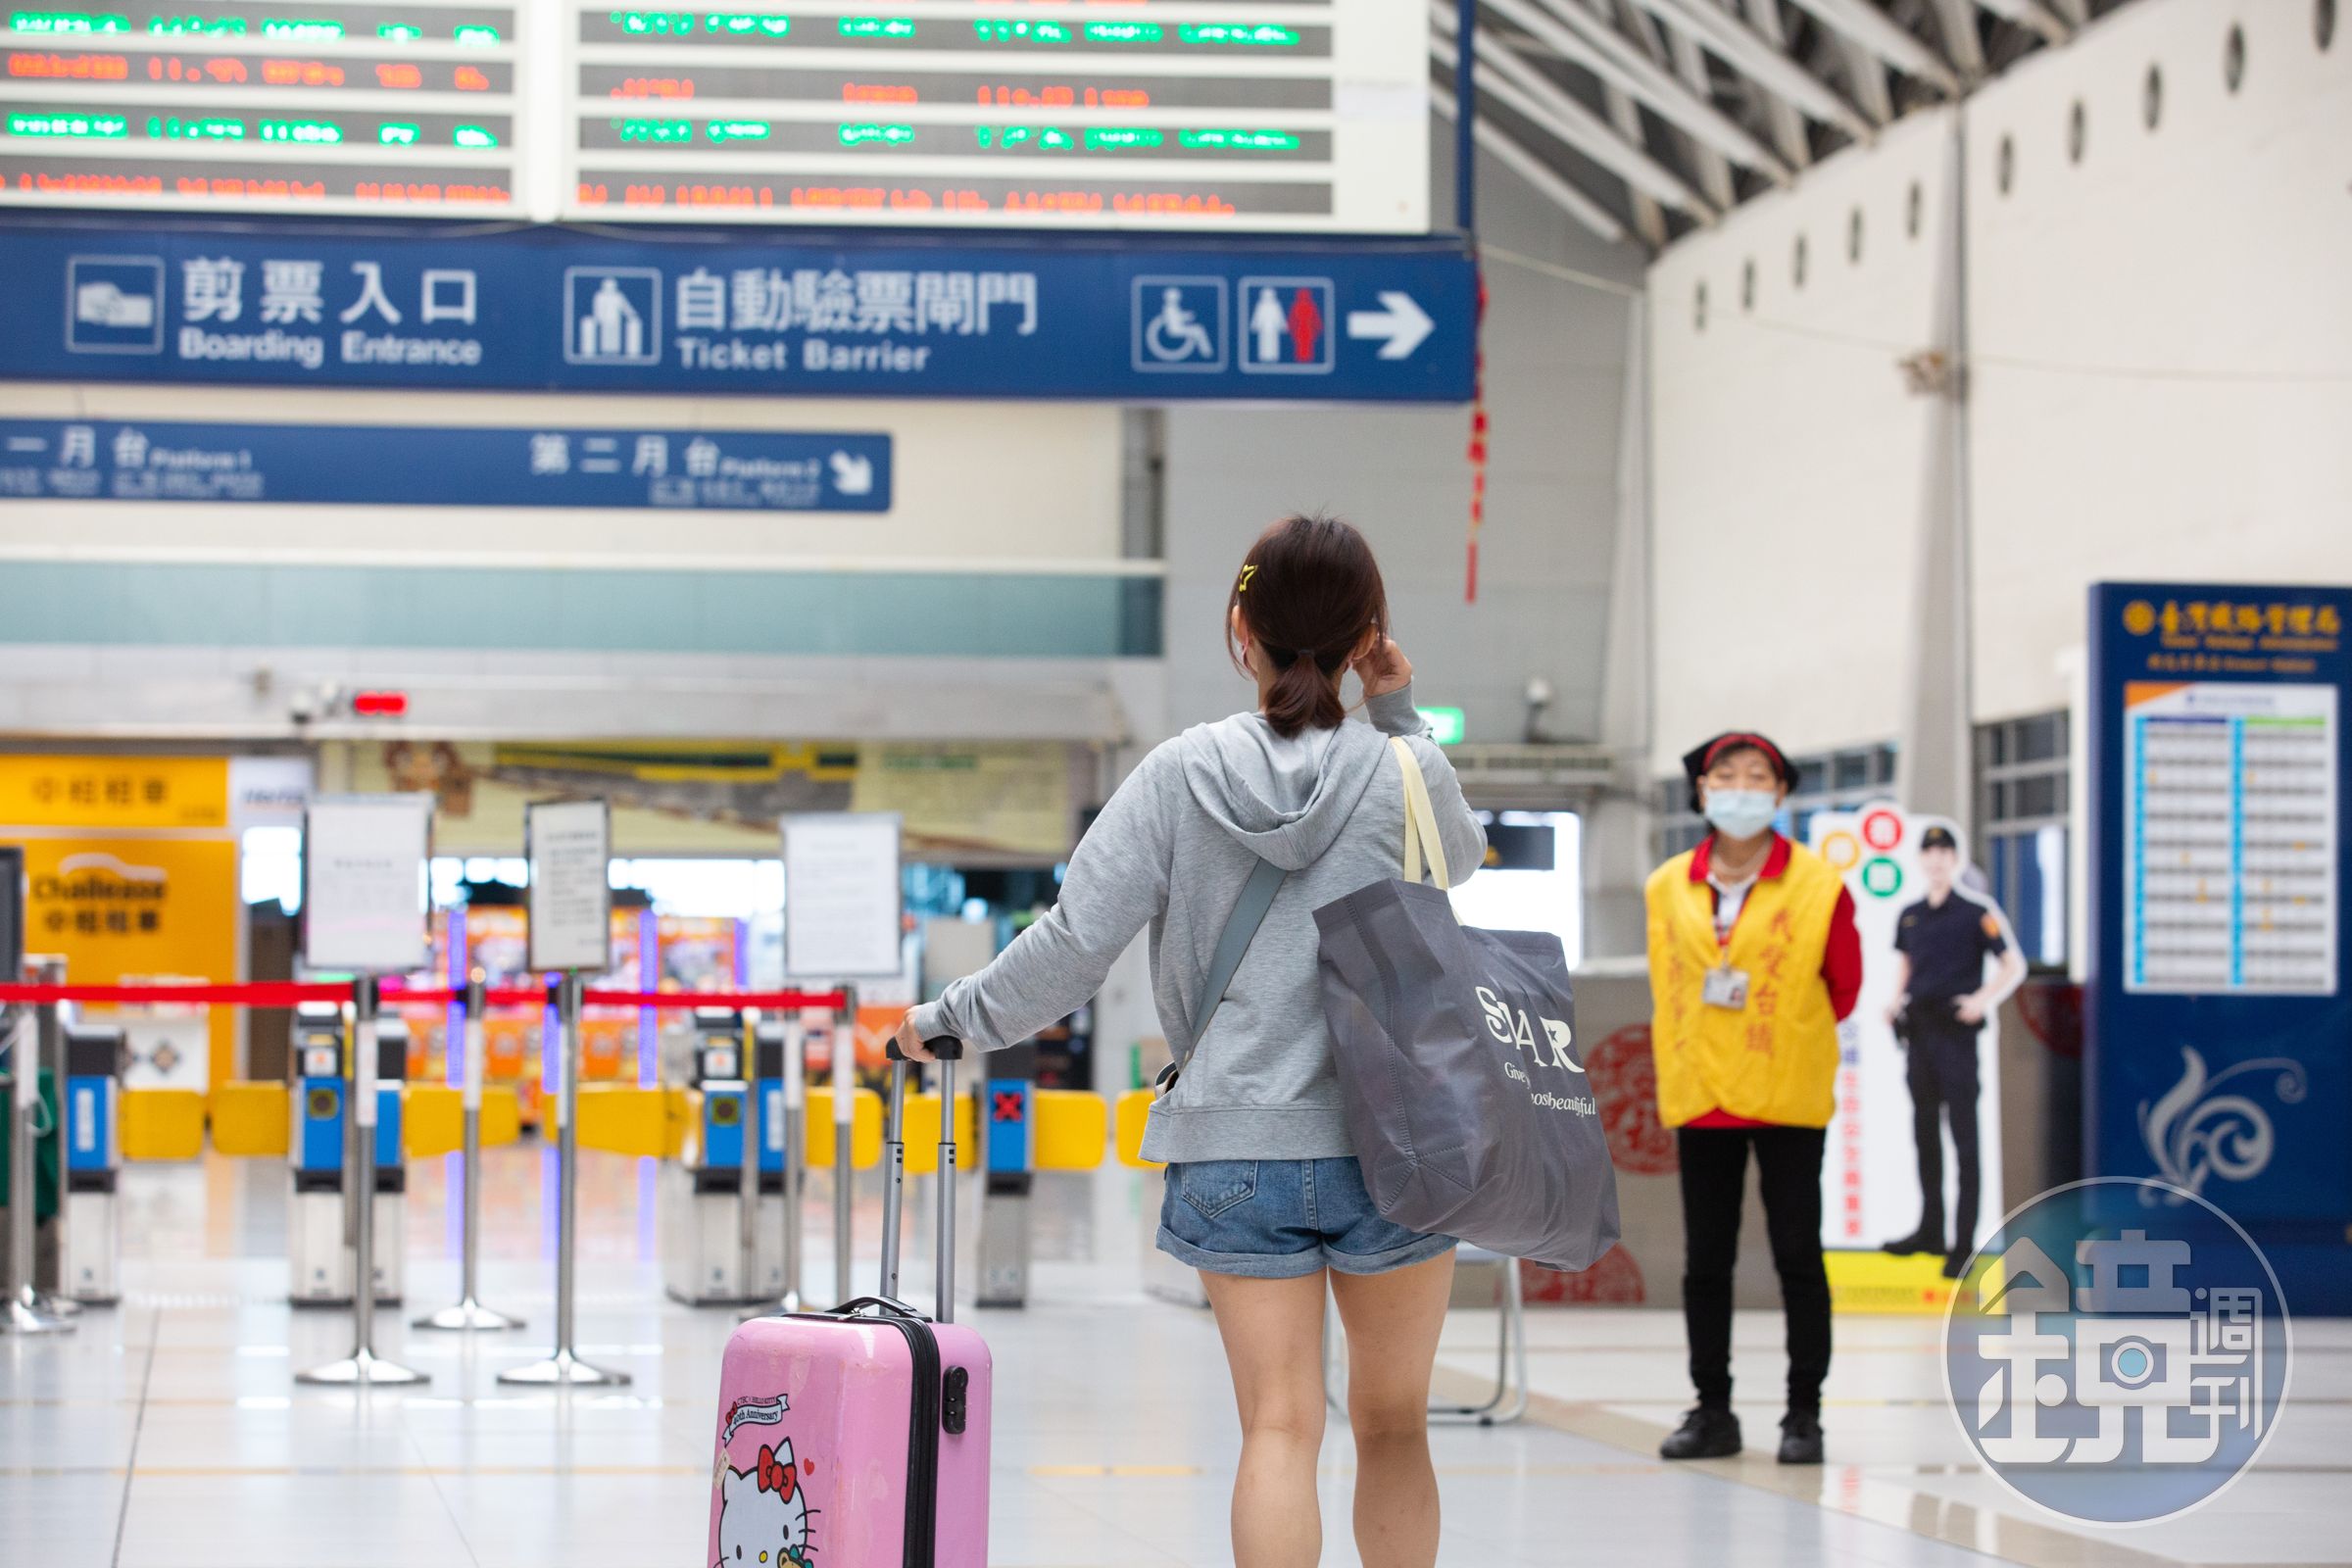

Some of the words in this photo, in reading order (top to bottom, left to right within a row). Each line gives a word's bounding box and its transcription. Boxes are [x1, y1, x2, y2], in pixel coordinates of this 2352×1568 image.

[182, 257, 477, 325] 剪票入口
[676, 268, 1038, 336] 自動驗票閘門
[179, 327, 324, 369] Boarding
[341, 330, 482, 366] Entrance
[677, 337, 788, 370] Ticket
[803, 339, 930, 372] Barrier
[530, 433, 718, 476] 第二月台
[746, 1408, 779, 1421] Anniversary
